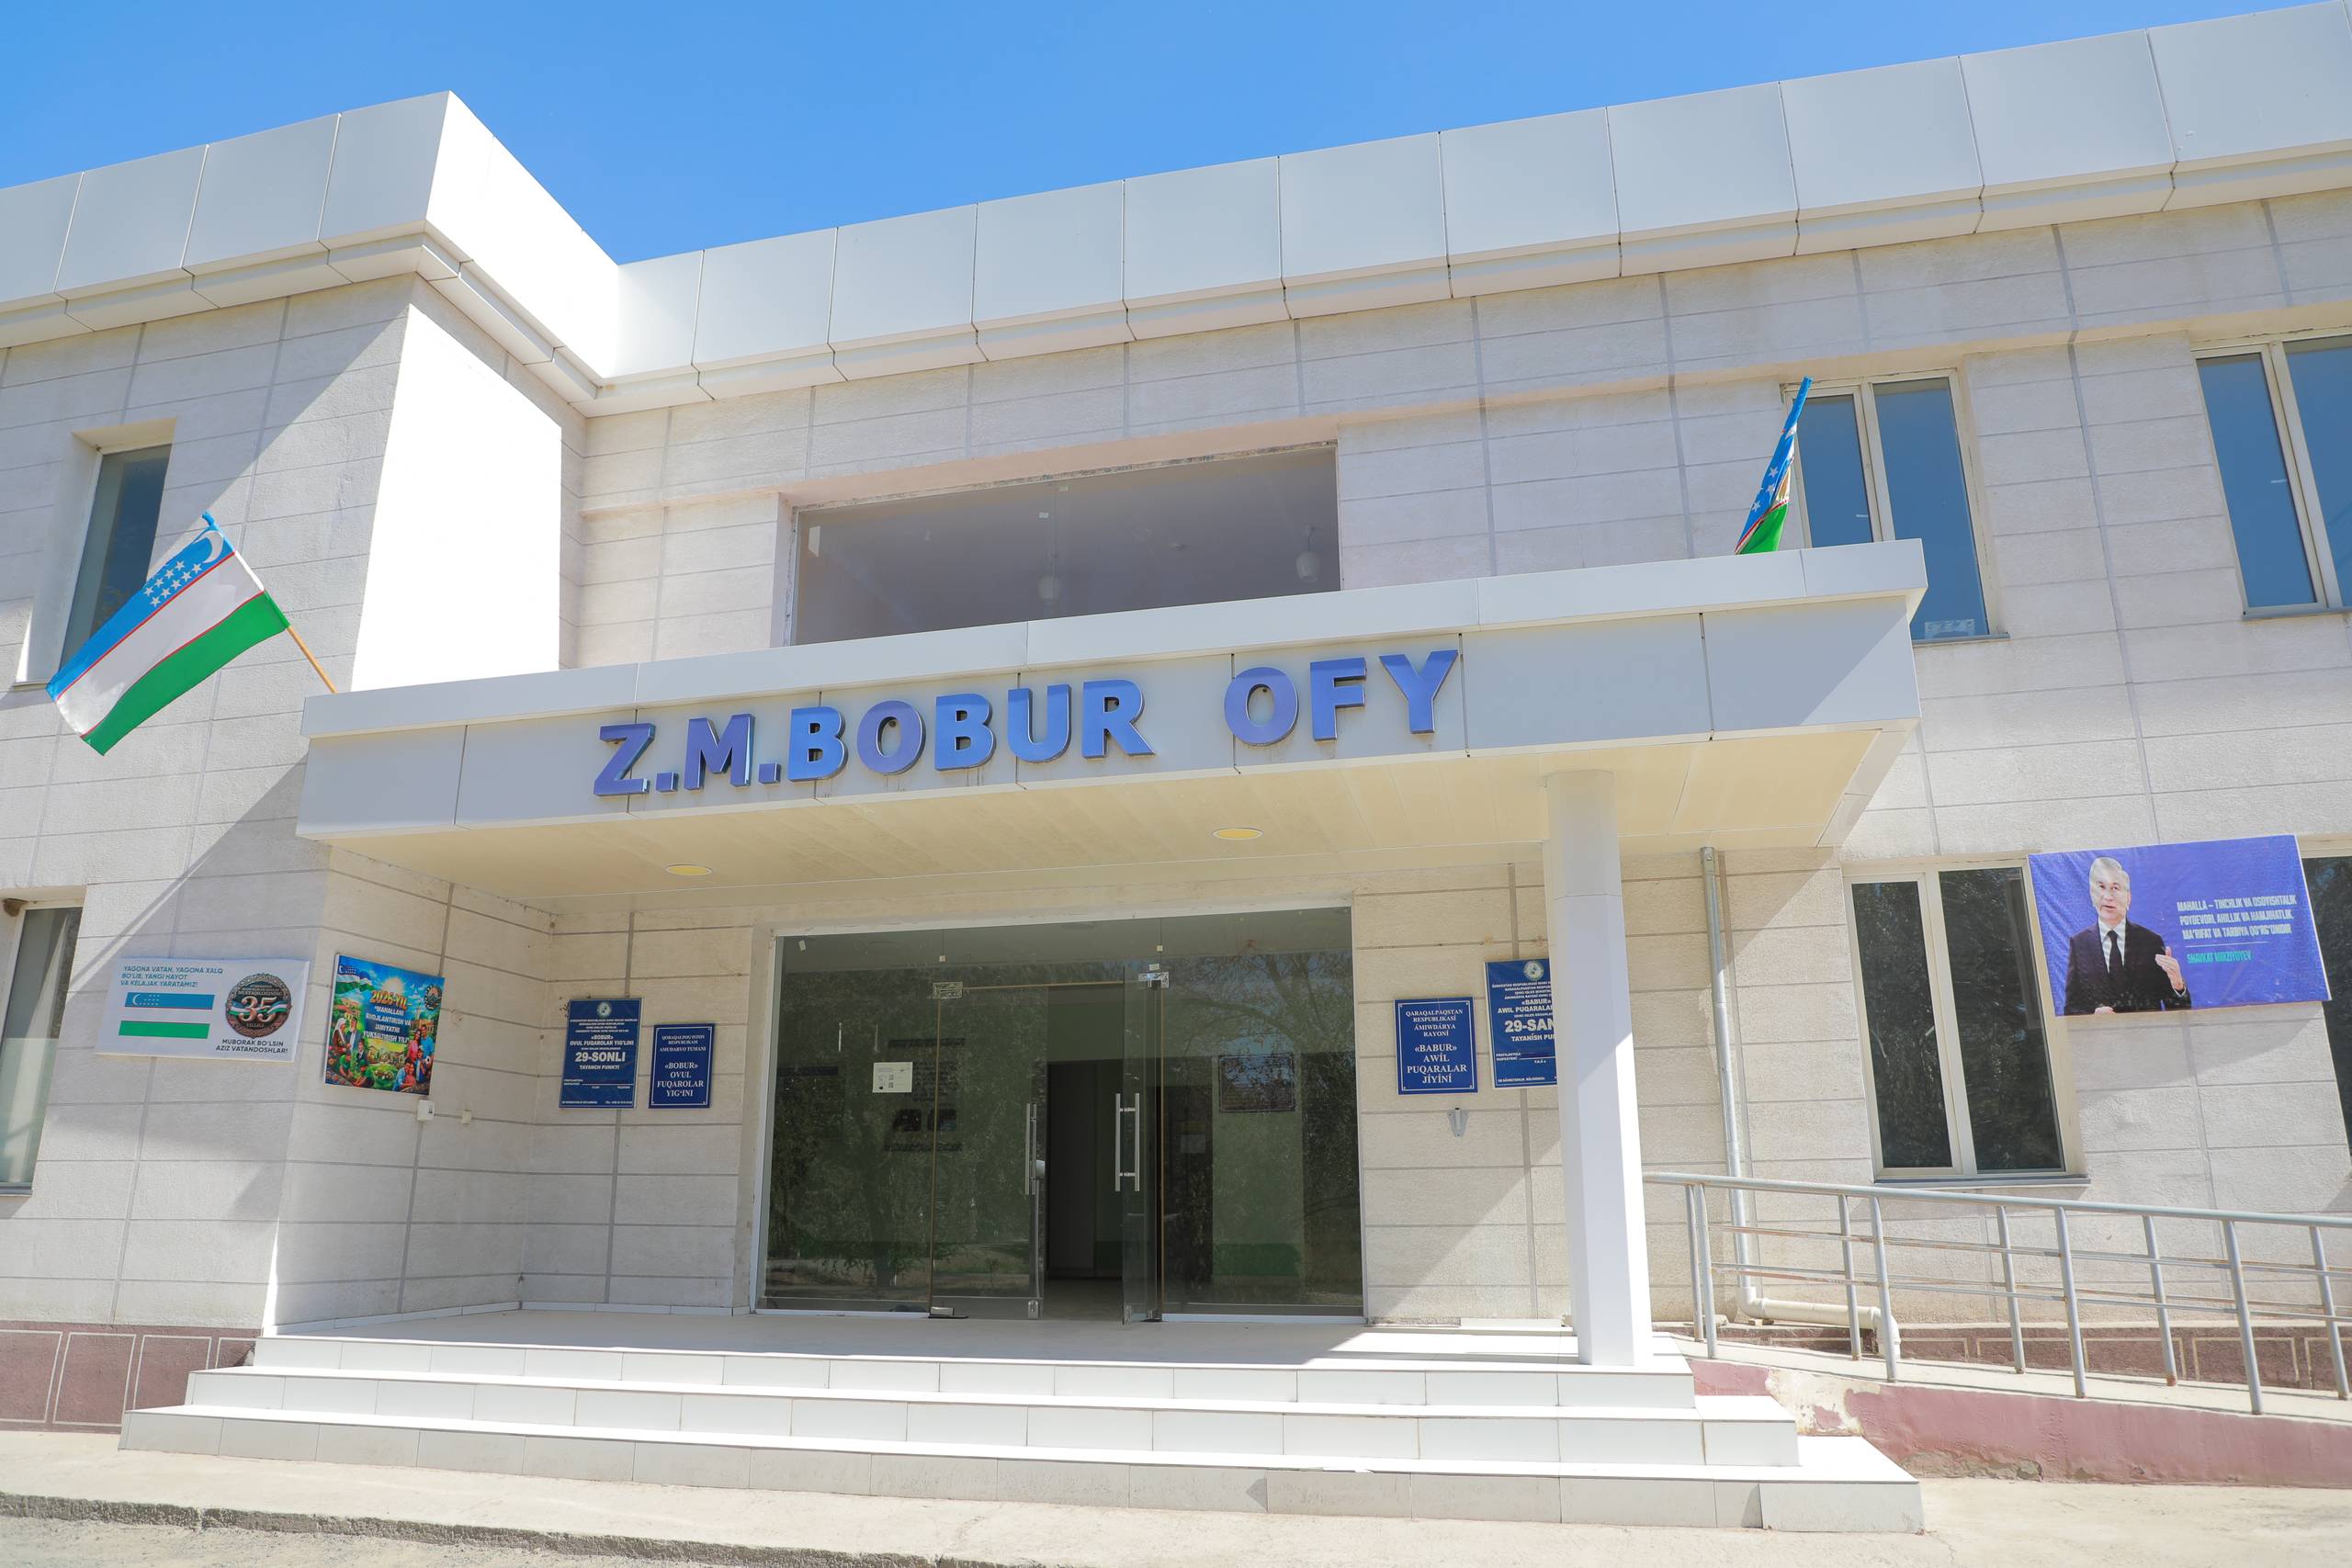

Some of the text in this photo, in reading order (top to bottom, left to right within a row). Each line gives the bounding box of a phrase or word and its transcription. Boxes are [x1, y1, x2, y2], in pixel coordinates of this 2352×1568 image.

[594, 649, 1459, 796] Z.M.BOBUR OFY
[2177, 900, 2208, 912] MAHALLA
[2243, 897, 2253, 908] VA
[2241, 911, 2251, 922] VA
[2212, 927, 2222, 938] VA
[239, 996, 277, 1022] 35
[1406, 1009, 1463, 1017] QARAQALPAQSTAN
[1415, 1043, 1457, 1053] «BABUR»
[574, 1051, 626, 1062] 29-SONLI
[1407, 1064, 1467, 1075] PUQARALAR
[657, 1080, 704, 1089] FUQAROLAR
